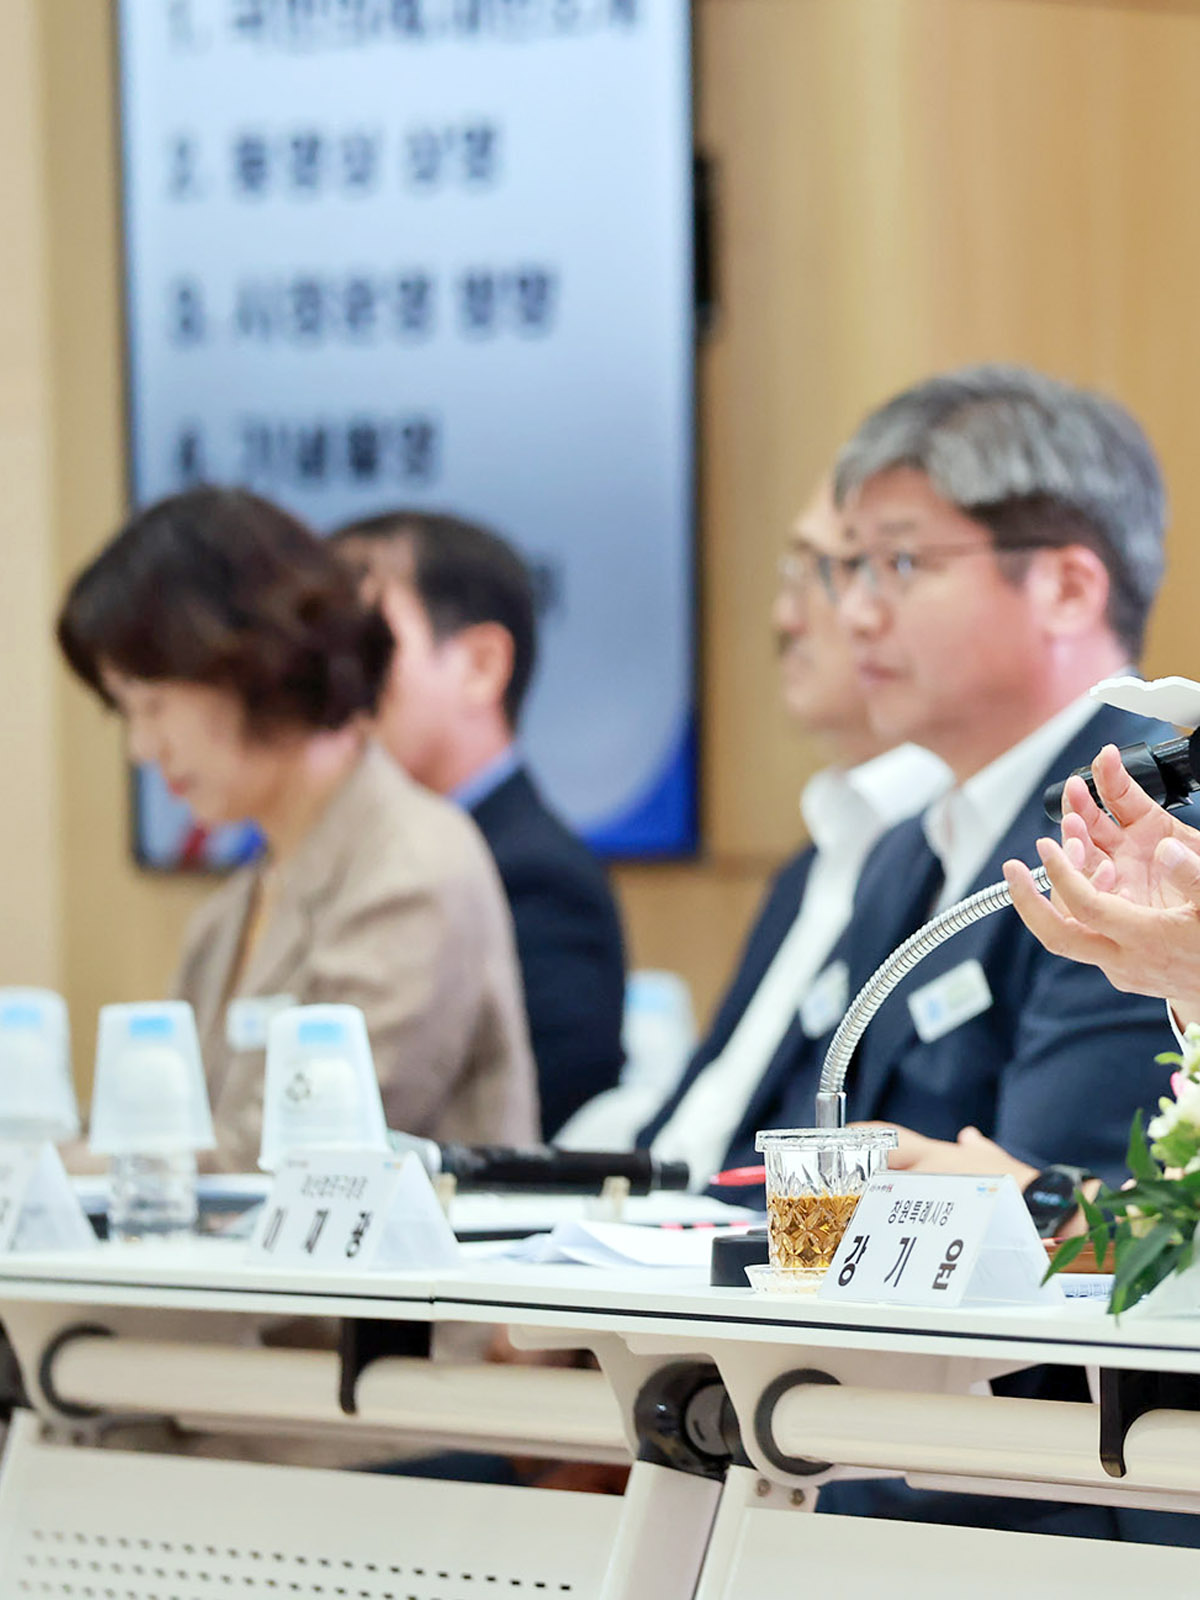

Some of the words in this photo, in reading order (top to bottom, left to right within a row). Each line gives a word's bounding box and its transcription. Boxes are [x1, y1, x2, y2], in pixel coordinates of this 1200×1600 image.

[887, 1199, 955, 1226] 창원특례시장
[837, 1234, 871, 1287] 강
[883, 1236, 918, 1288] 기
